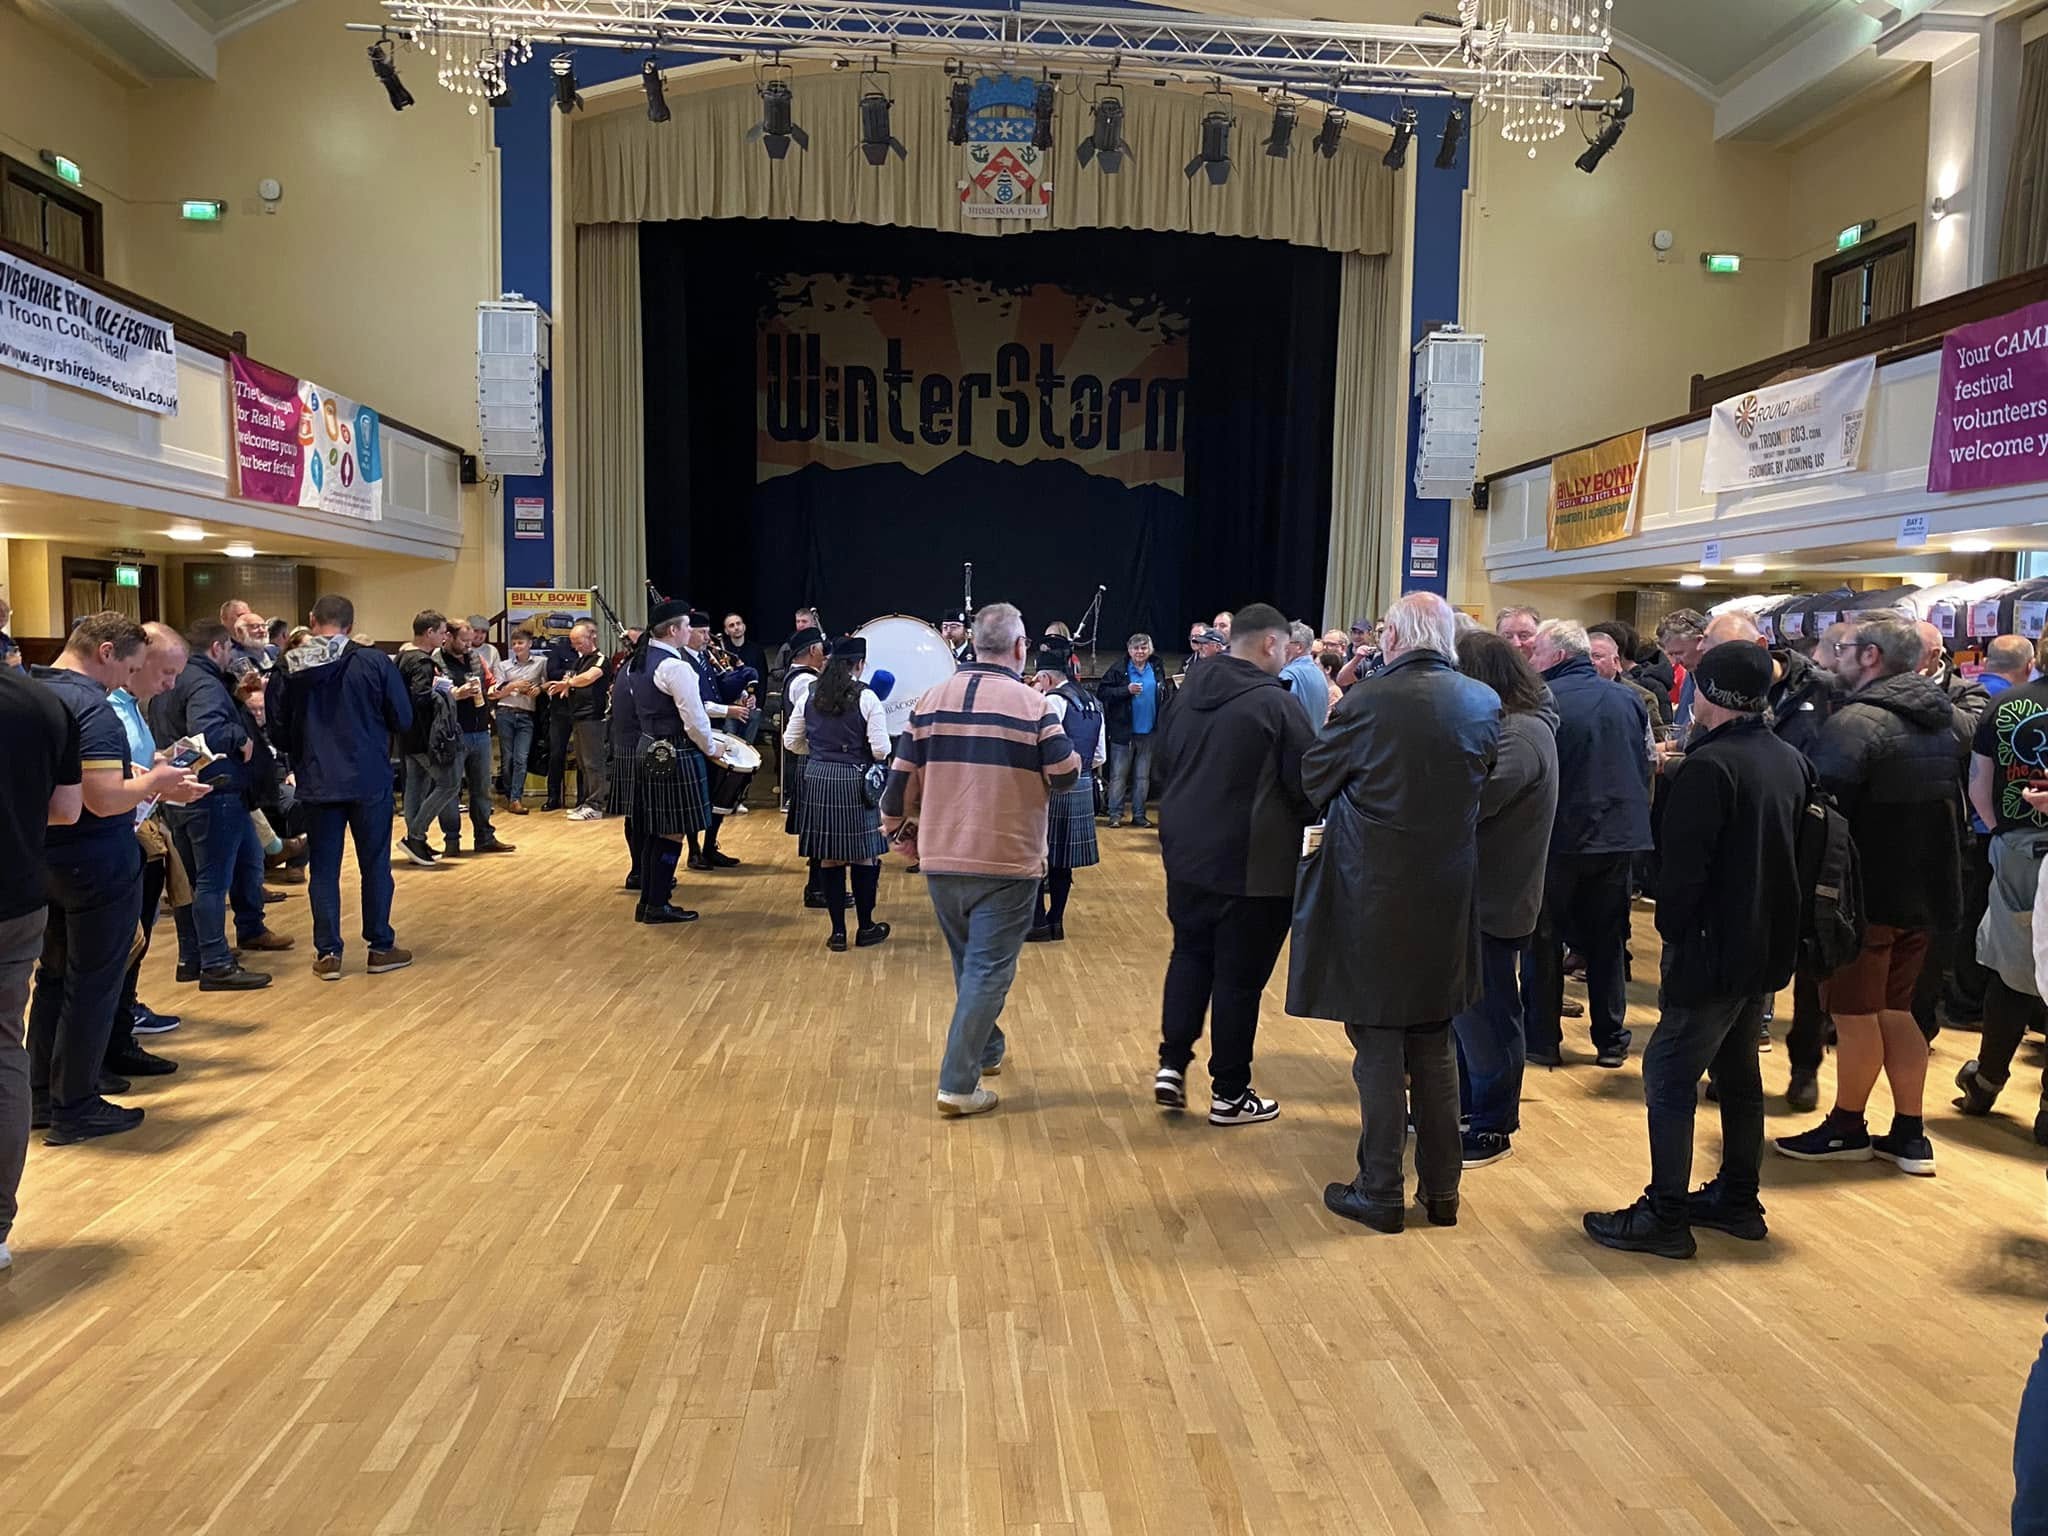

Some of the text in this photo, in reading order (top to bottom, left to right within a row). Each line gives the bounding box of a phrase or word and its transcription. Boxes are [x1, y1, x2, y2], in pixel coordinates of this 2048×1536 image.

[9, 300, 53, 332] Troon
[105, 339, 128, 363] Hall
[95, 305, 121, 337] ALE
[118, 316, 173, 355] FESTIVAL
[1957, 346, 1991, 369] Your
[236, 381, 257, 400] The
[766, 334, 1187, 451] WinterStorm
[1954, 367, 2014, 401] festival
[251, 408, 271, 428] Real
[272, 415, 286, 431] Ale
[1952, 399, 2048, 432] volunteers
[1949, 436, 2034, 464] welcome
[252, 455, 273, 473] beer
[1775, 460, 1784, 474] BY
[1814, 452, 1825, 468] US
[1556, 476, 1592, 500] BILLY
[511, 592, 587, 603] BILLY BOWIE
